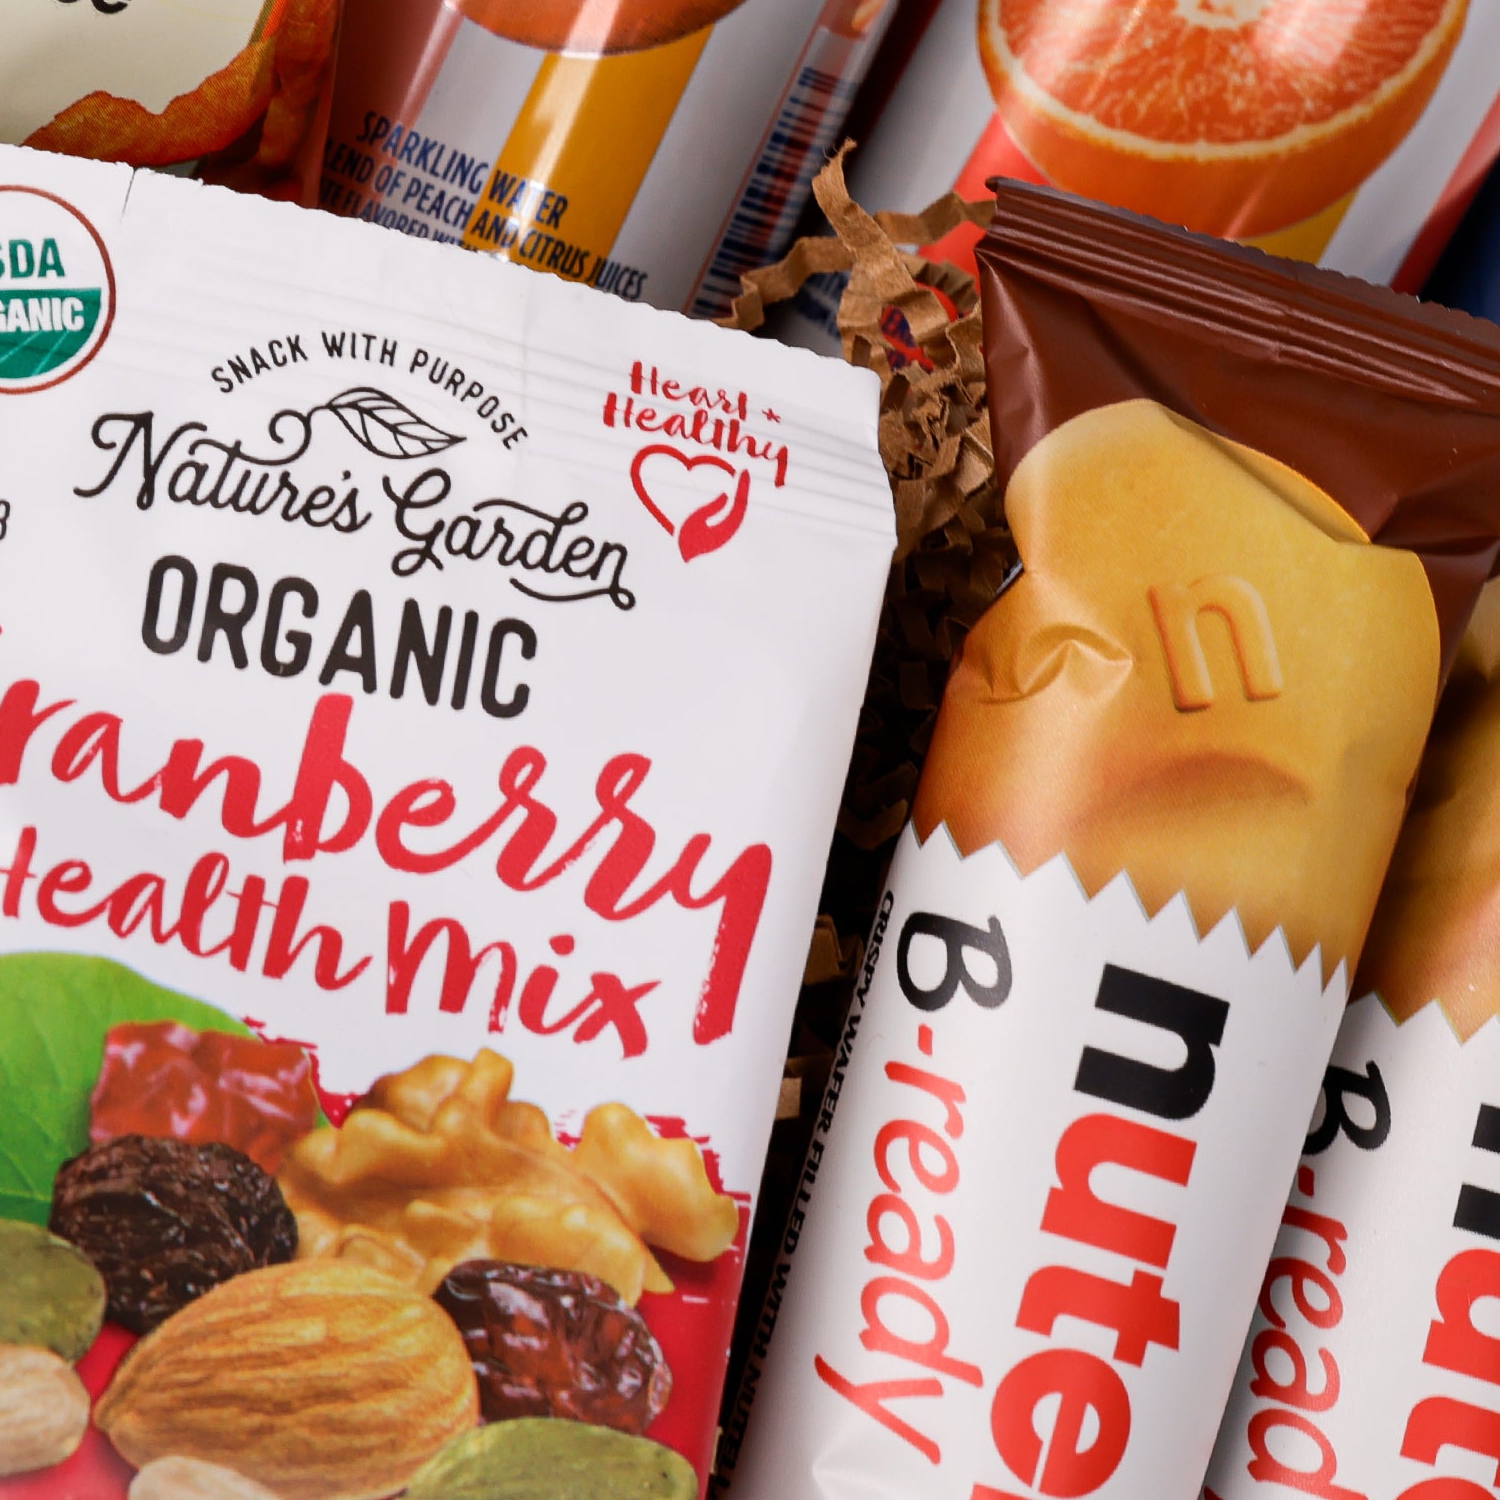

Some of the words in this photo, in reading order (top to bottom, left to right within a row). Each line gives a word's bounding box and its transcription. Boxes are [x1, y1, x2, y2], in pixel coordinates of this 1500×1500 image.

[356, 110, 489, 195] SPARKLING
[488, 169, 569, 230] WATER
[374, 164, 408, 198] OF
[406, 177, 476, 231] PEACH
[471, 209, 520, 248] AND
[519, 230, 590, 280] CITRUS
[585, 254, 649, 300] JUICES
[211, 334, 308, 393] SNACK
[321, 330, 398, 367] WITH
[410, 348, 529, 450] PURPOSE
[603, 392, 789, 488] Healthy
[73, 410, 372, 533] Nature's
[382, 467, 636, 610] Garden
[141, 554, 538, 719] ORGANIC
[856, 890, 894, 1008] CRISPY
[816, 1014, 861, 1135] WAFER
[815, 910, 1013, 1466] B-ready
[1203, 1060, 1392, 1500] B-read
